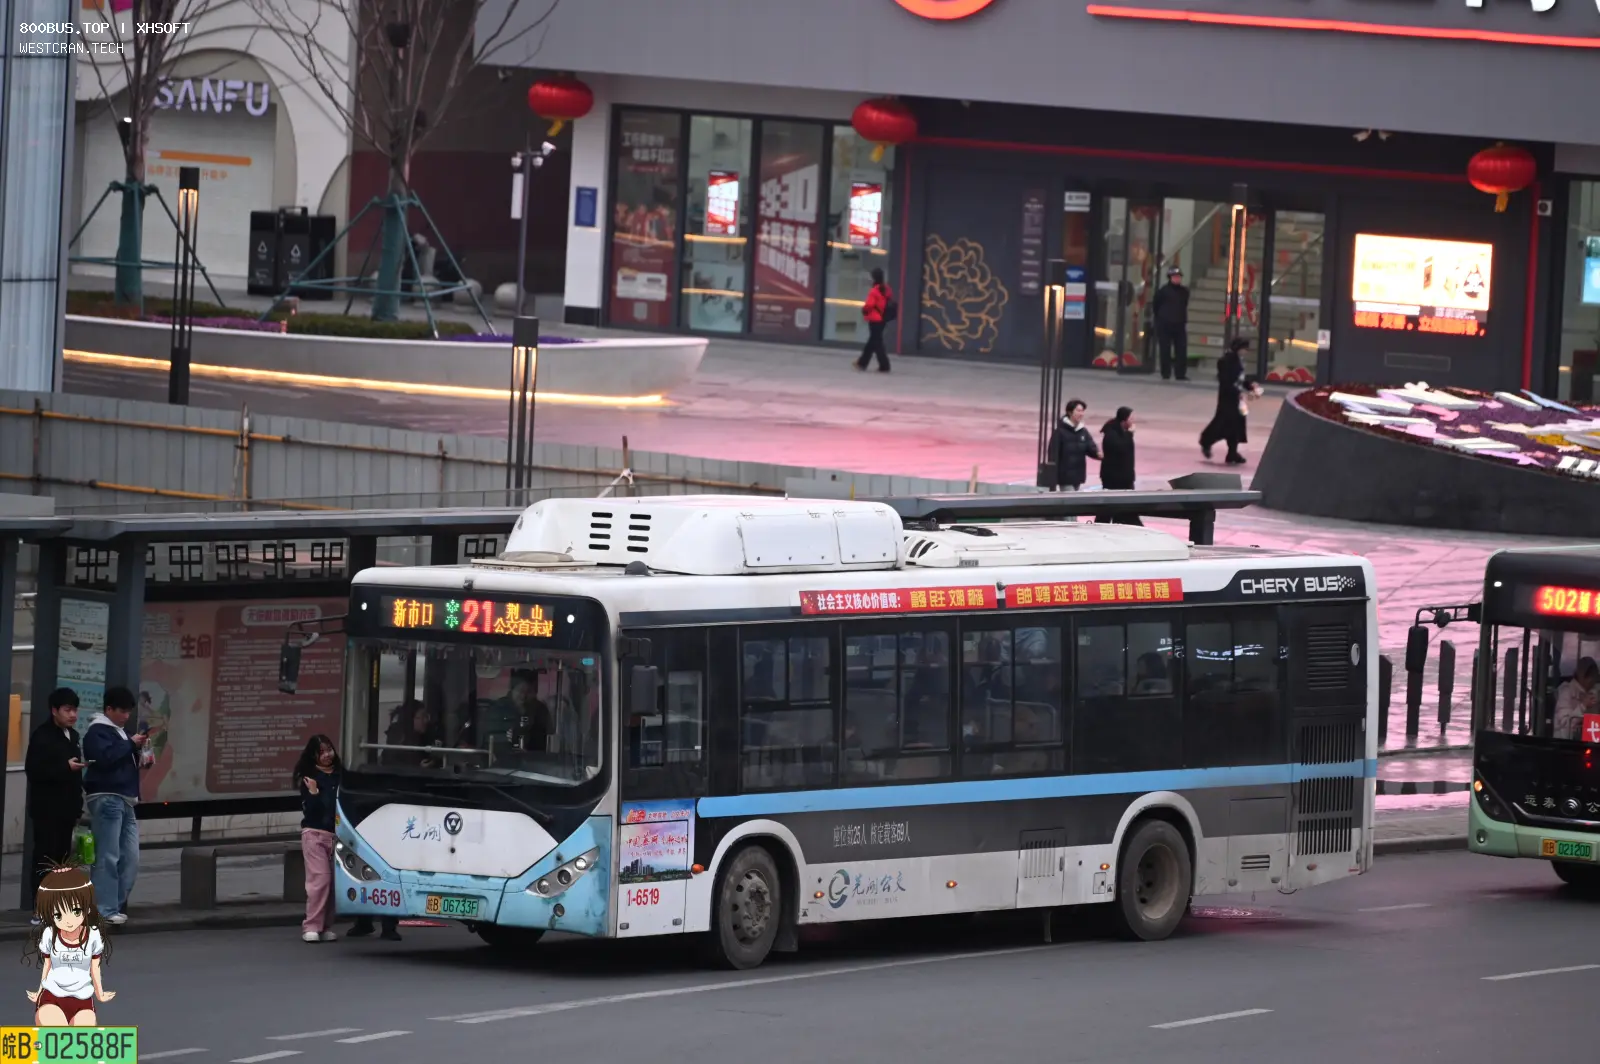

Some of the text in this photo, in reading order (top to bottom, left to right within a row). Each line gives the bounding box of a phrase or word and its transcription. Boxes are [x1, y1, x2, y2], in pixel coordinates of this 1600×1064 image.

[154, 76, 270, 117] SANFU
[1016, 581, 1171, 604] 自由 平等 公正 法治 爱国 敬业 诚信 友善
[1240, 576, 1338, 594] CHERY BUS
[909, 591, 928, 608] 富强
[929, 590, 947, 607] 民主
[949, 589, 966, 606] 文明
[967, 588, 985, 606] 和谐
[393, 598, 433, 628] 新市口
[462, 599, 493, 633] 21
[493, 617, 553, 637] 公交首末站
[443, 899, 477, 914] 06733F
[627, 888, 660, 906] 1-6519
